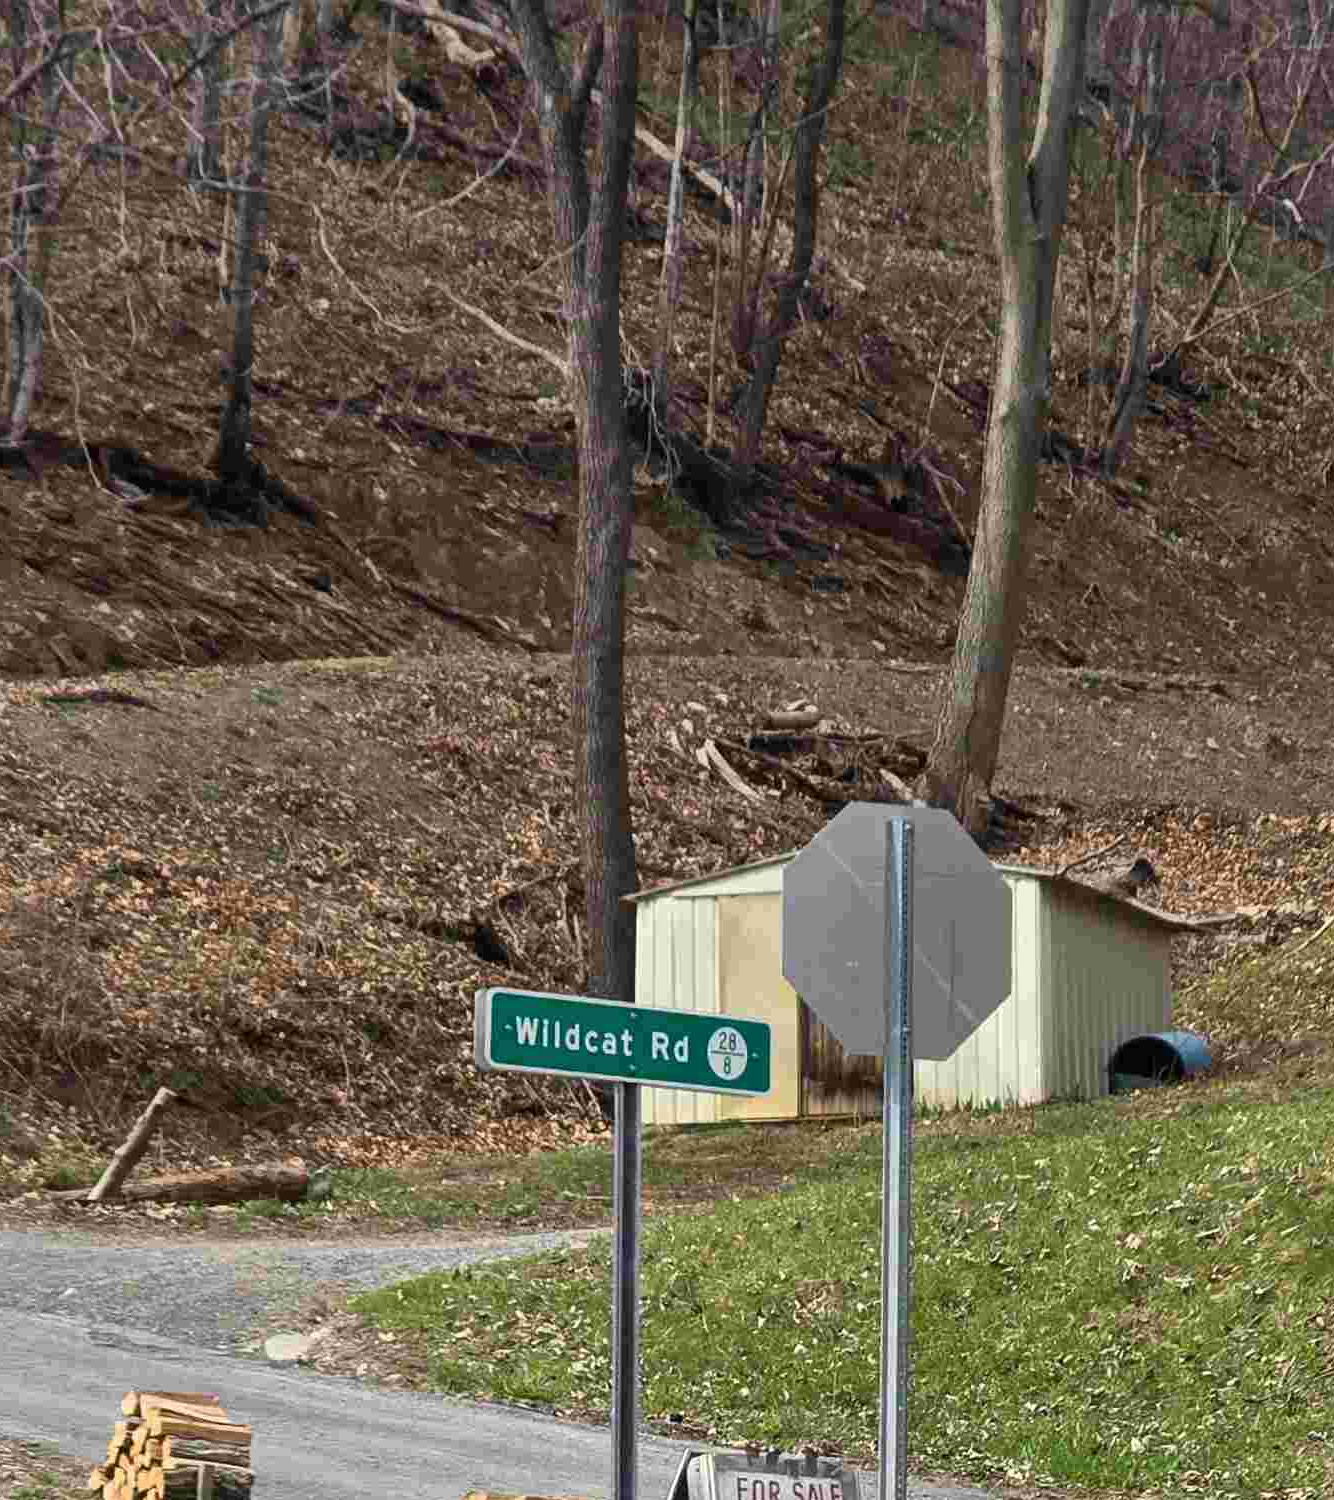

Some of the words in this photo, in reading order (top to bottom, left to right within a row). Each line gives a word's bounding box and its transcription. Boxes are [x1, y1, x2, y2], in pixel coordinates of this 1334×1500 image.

[515, 1015, 634, 1057] Wildcat
[650, 1031, 690, 1063] Rd
[718, 1033, 738, 1051] 28
[723, 1056, 732, 1075] 8
